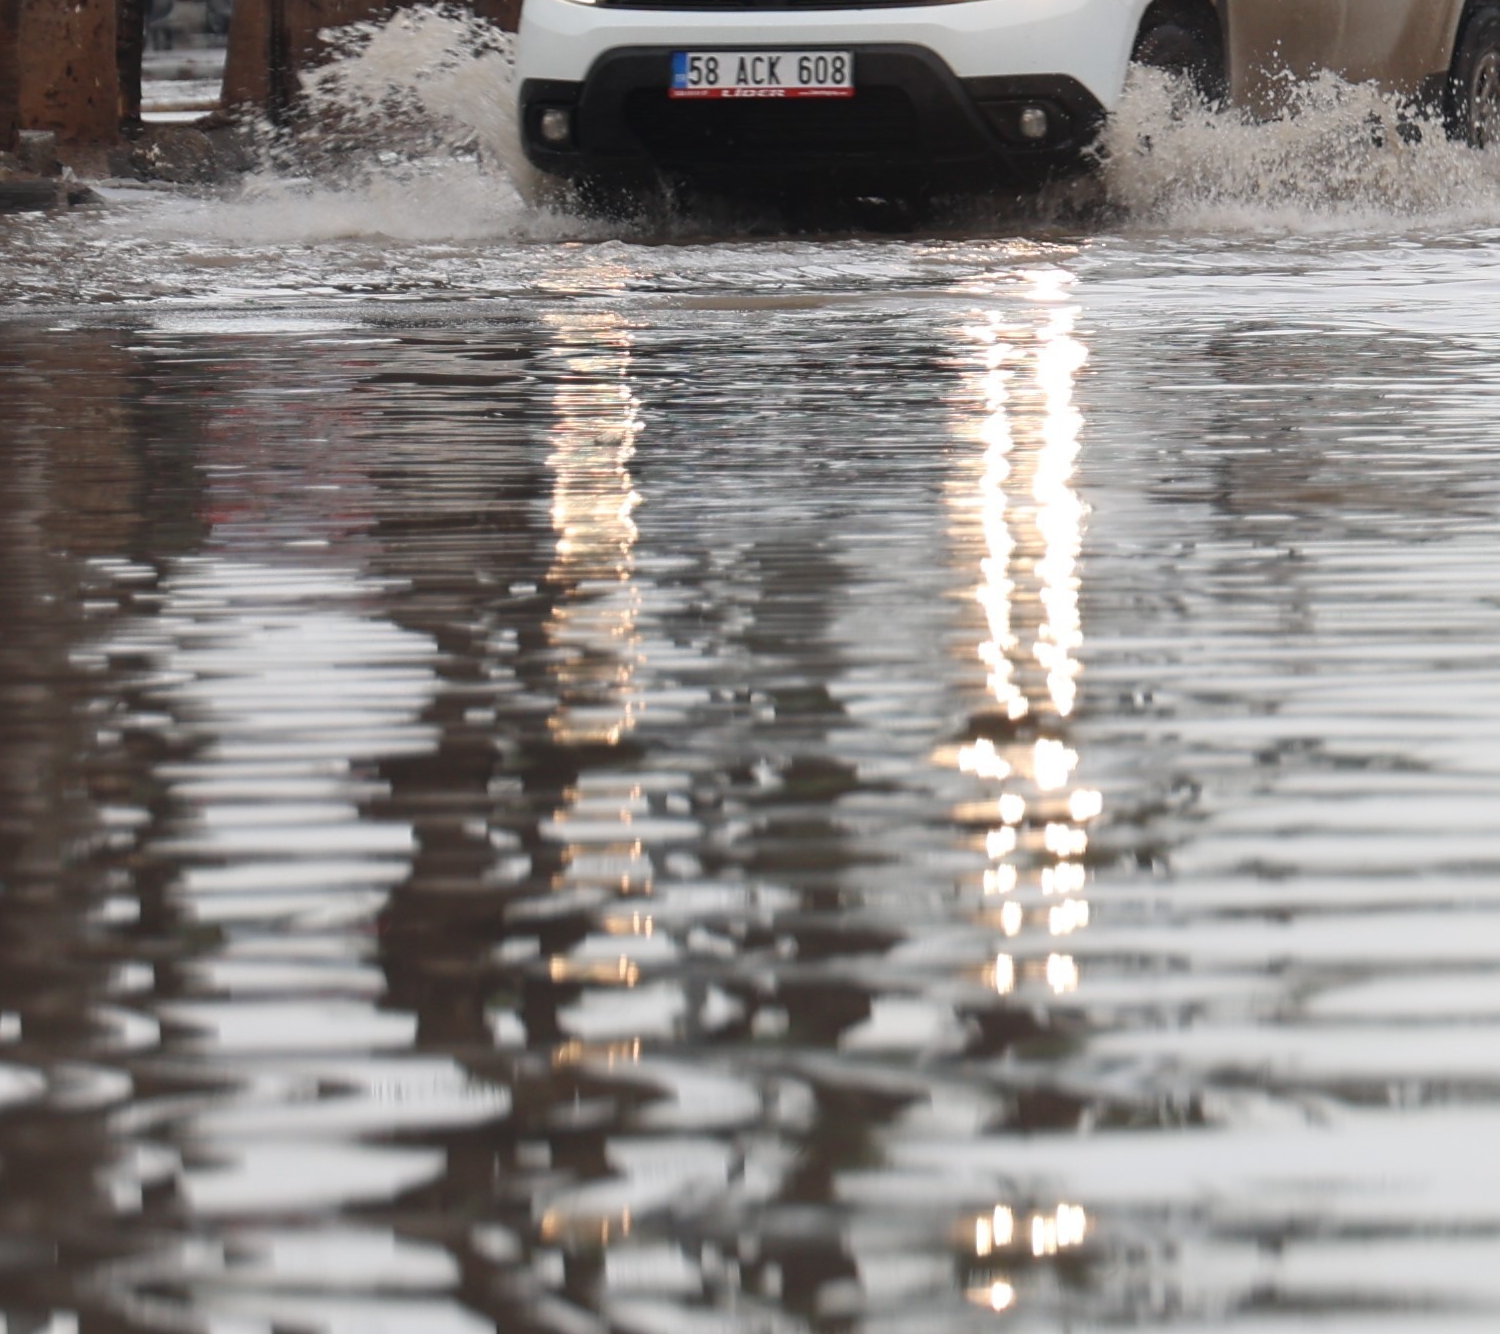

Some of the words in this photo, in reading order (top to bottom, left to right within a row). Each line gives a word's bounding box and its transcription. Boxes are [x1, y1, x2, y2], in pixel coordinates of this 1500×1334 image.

[689, 56, 719, 85] 58
[736, 56, 781, 85] ACK
[799, 56, 846, 85] 608
